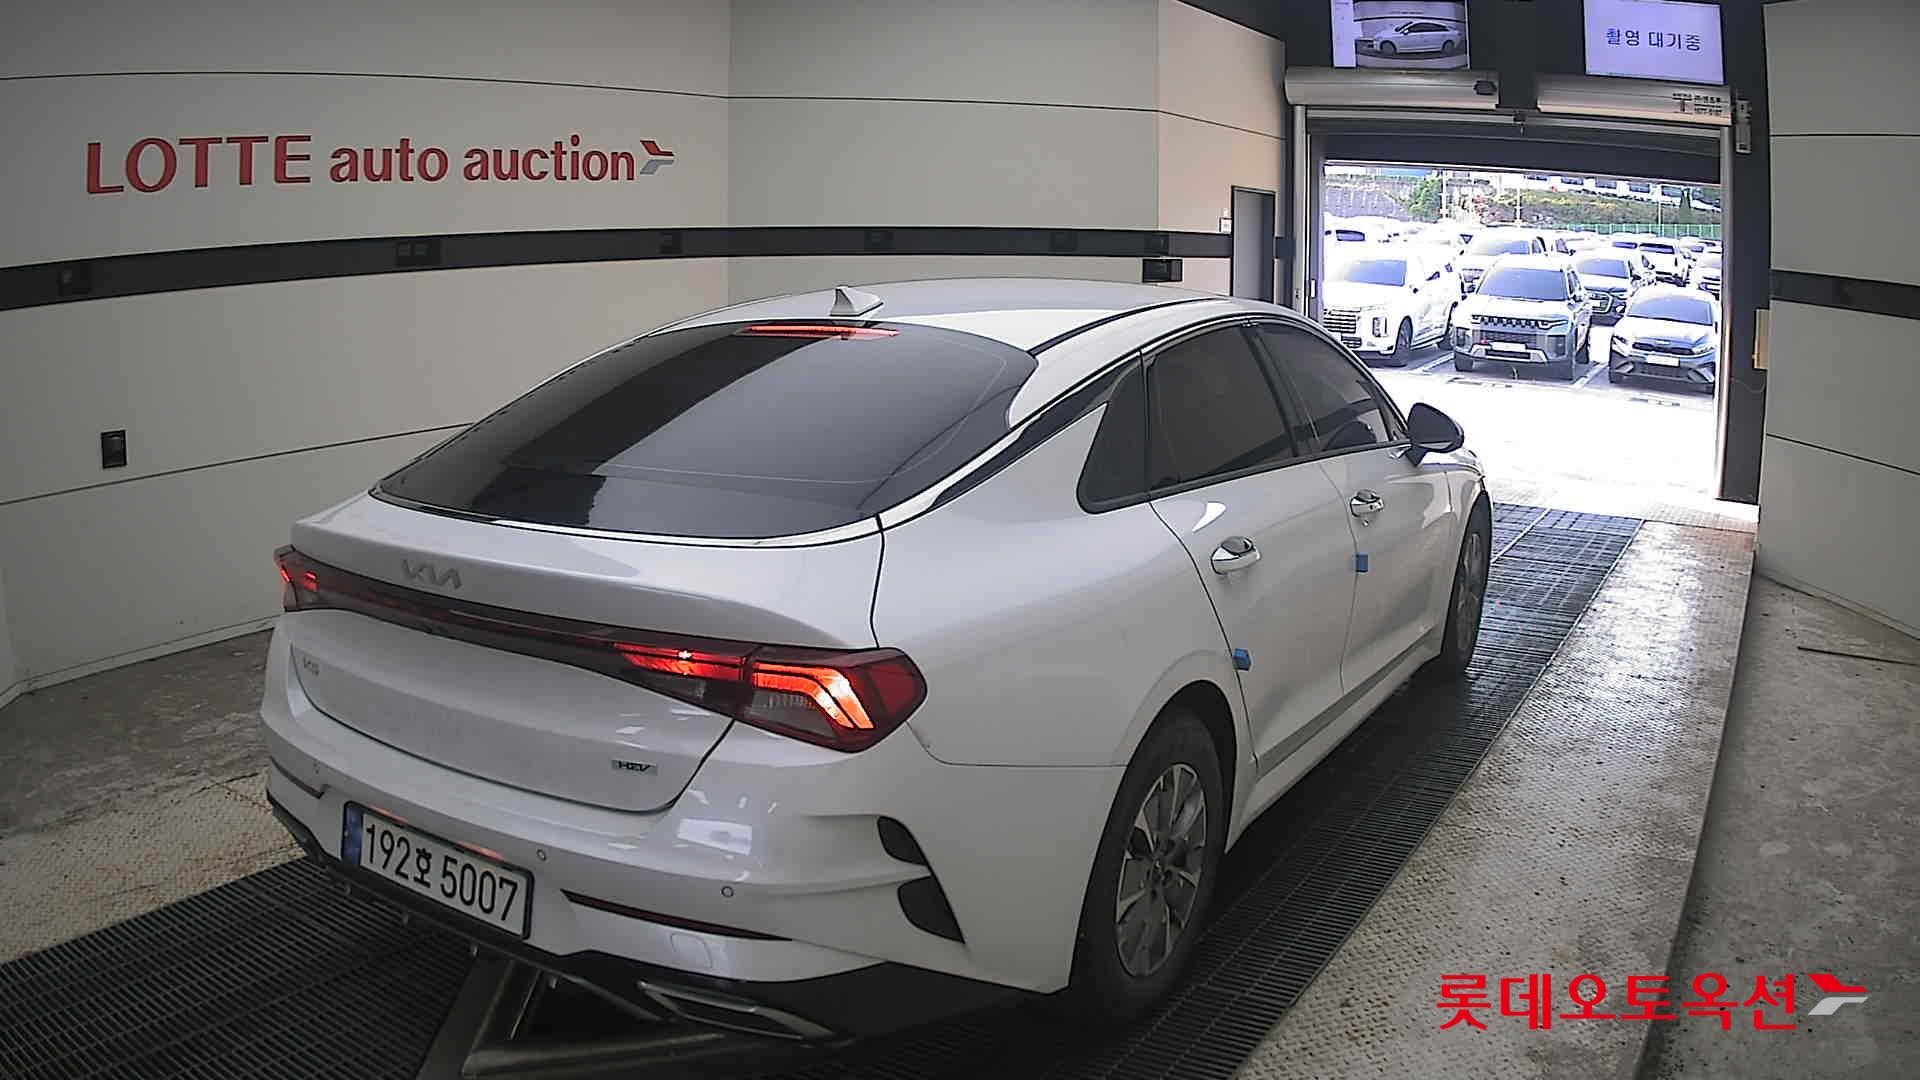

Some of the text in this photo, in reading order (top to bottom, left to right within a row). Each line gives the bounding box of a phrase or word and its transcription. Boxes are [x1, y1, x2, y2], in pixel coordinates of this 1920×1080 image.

[1606, 28, 1701, 51] 촬영 대기중
[86, 134, 636, 194] LOTTE auto auction
[366, 824, 518, 921] 192호 5007
